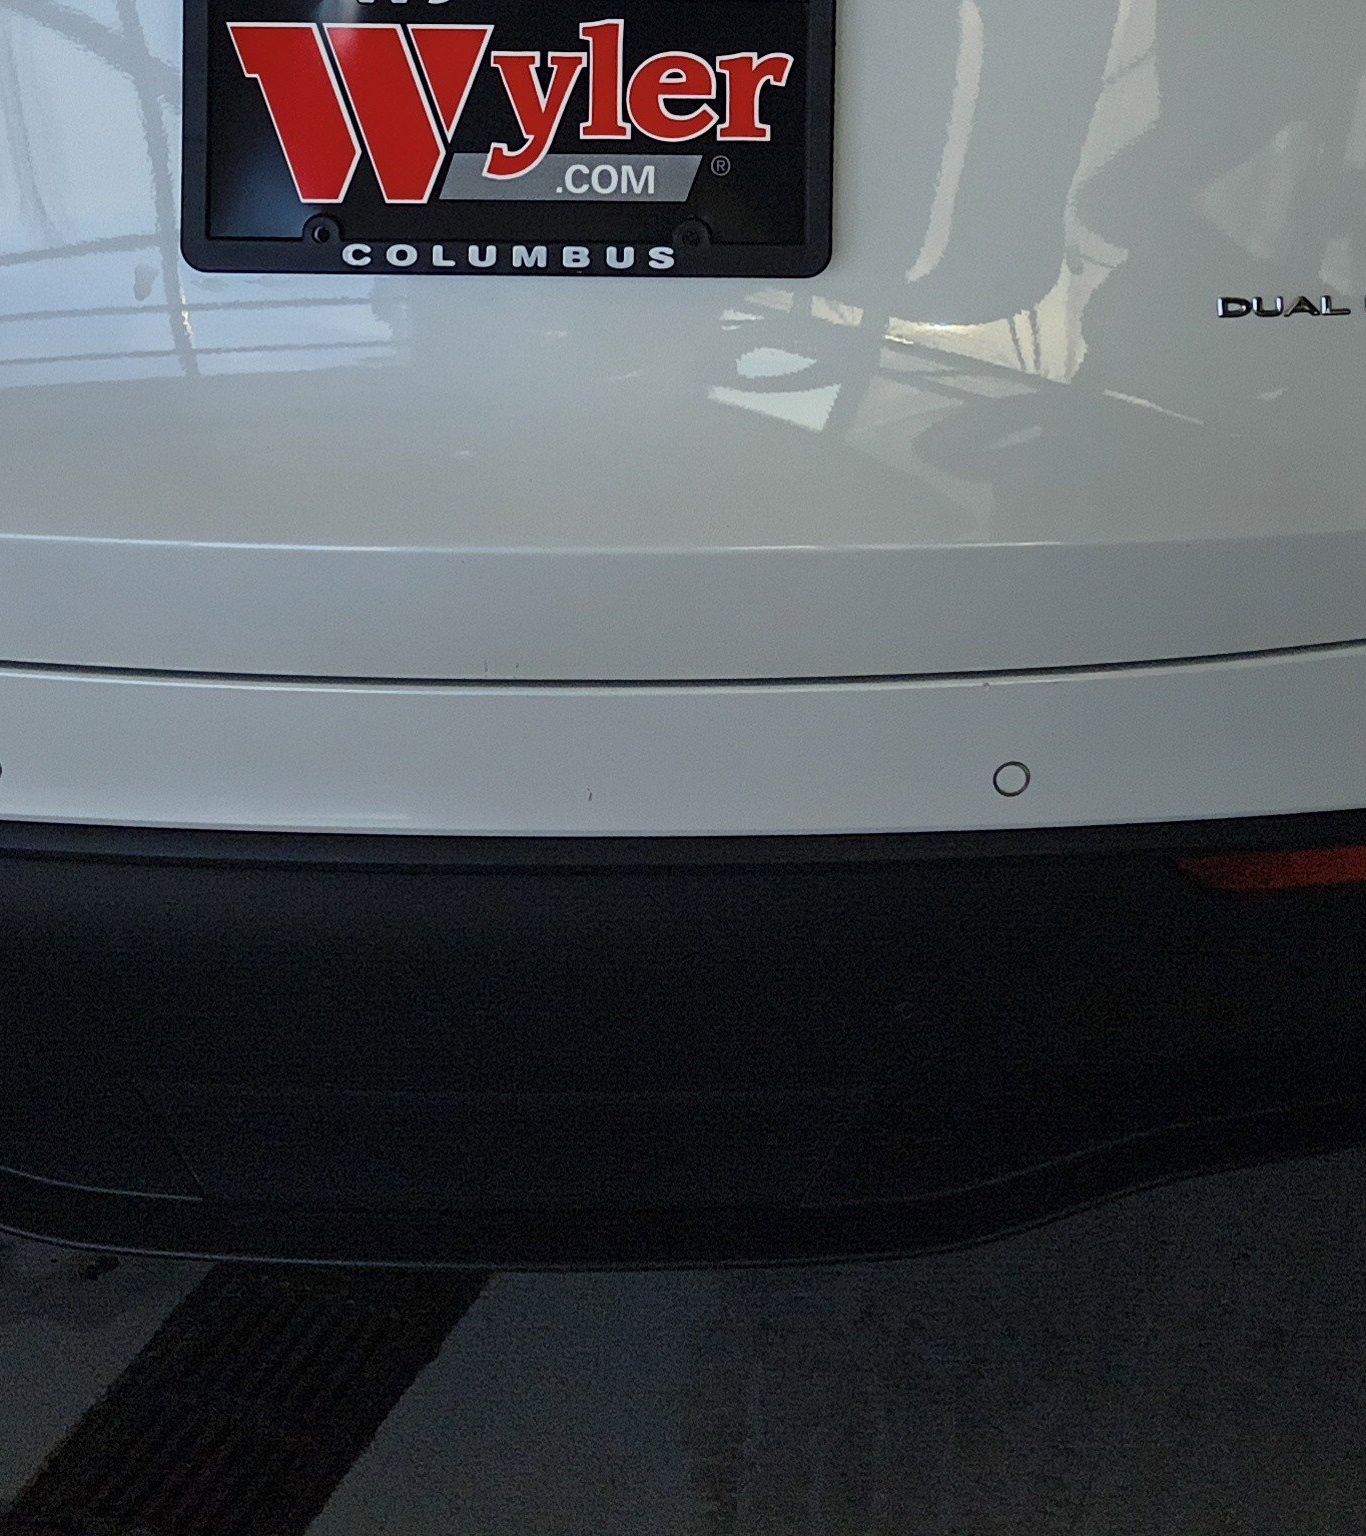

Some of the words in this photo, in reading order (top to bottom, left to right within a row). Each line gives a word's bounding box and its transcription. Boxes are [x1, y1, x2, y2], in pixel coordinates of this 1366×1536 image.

[227, 19, 794, 204] Wyler
[555, 164, 655, 196] .COM
[342, 242, 676, 270] COLUMBUS
[1217, 295, 1351, 318] DUAL
